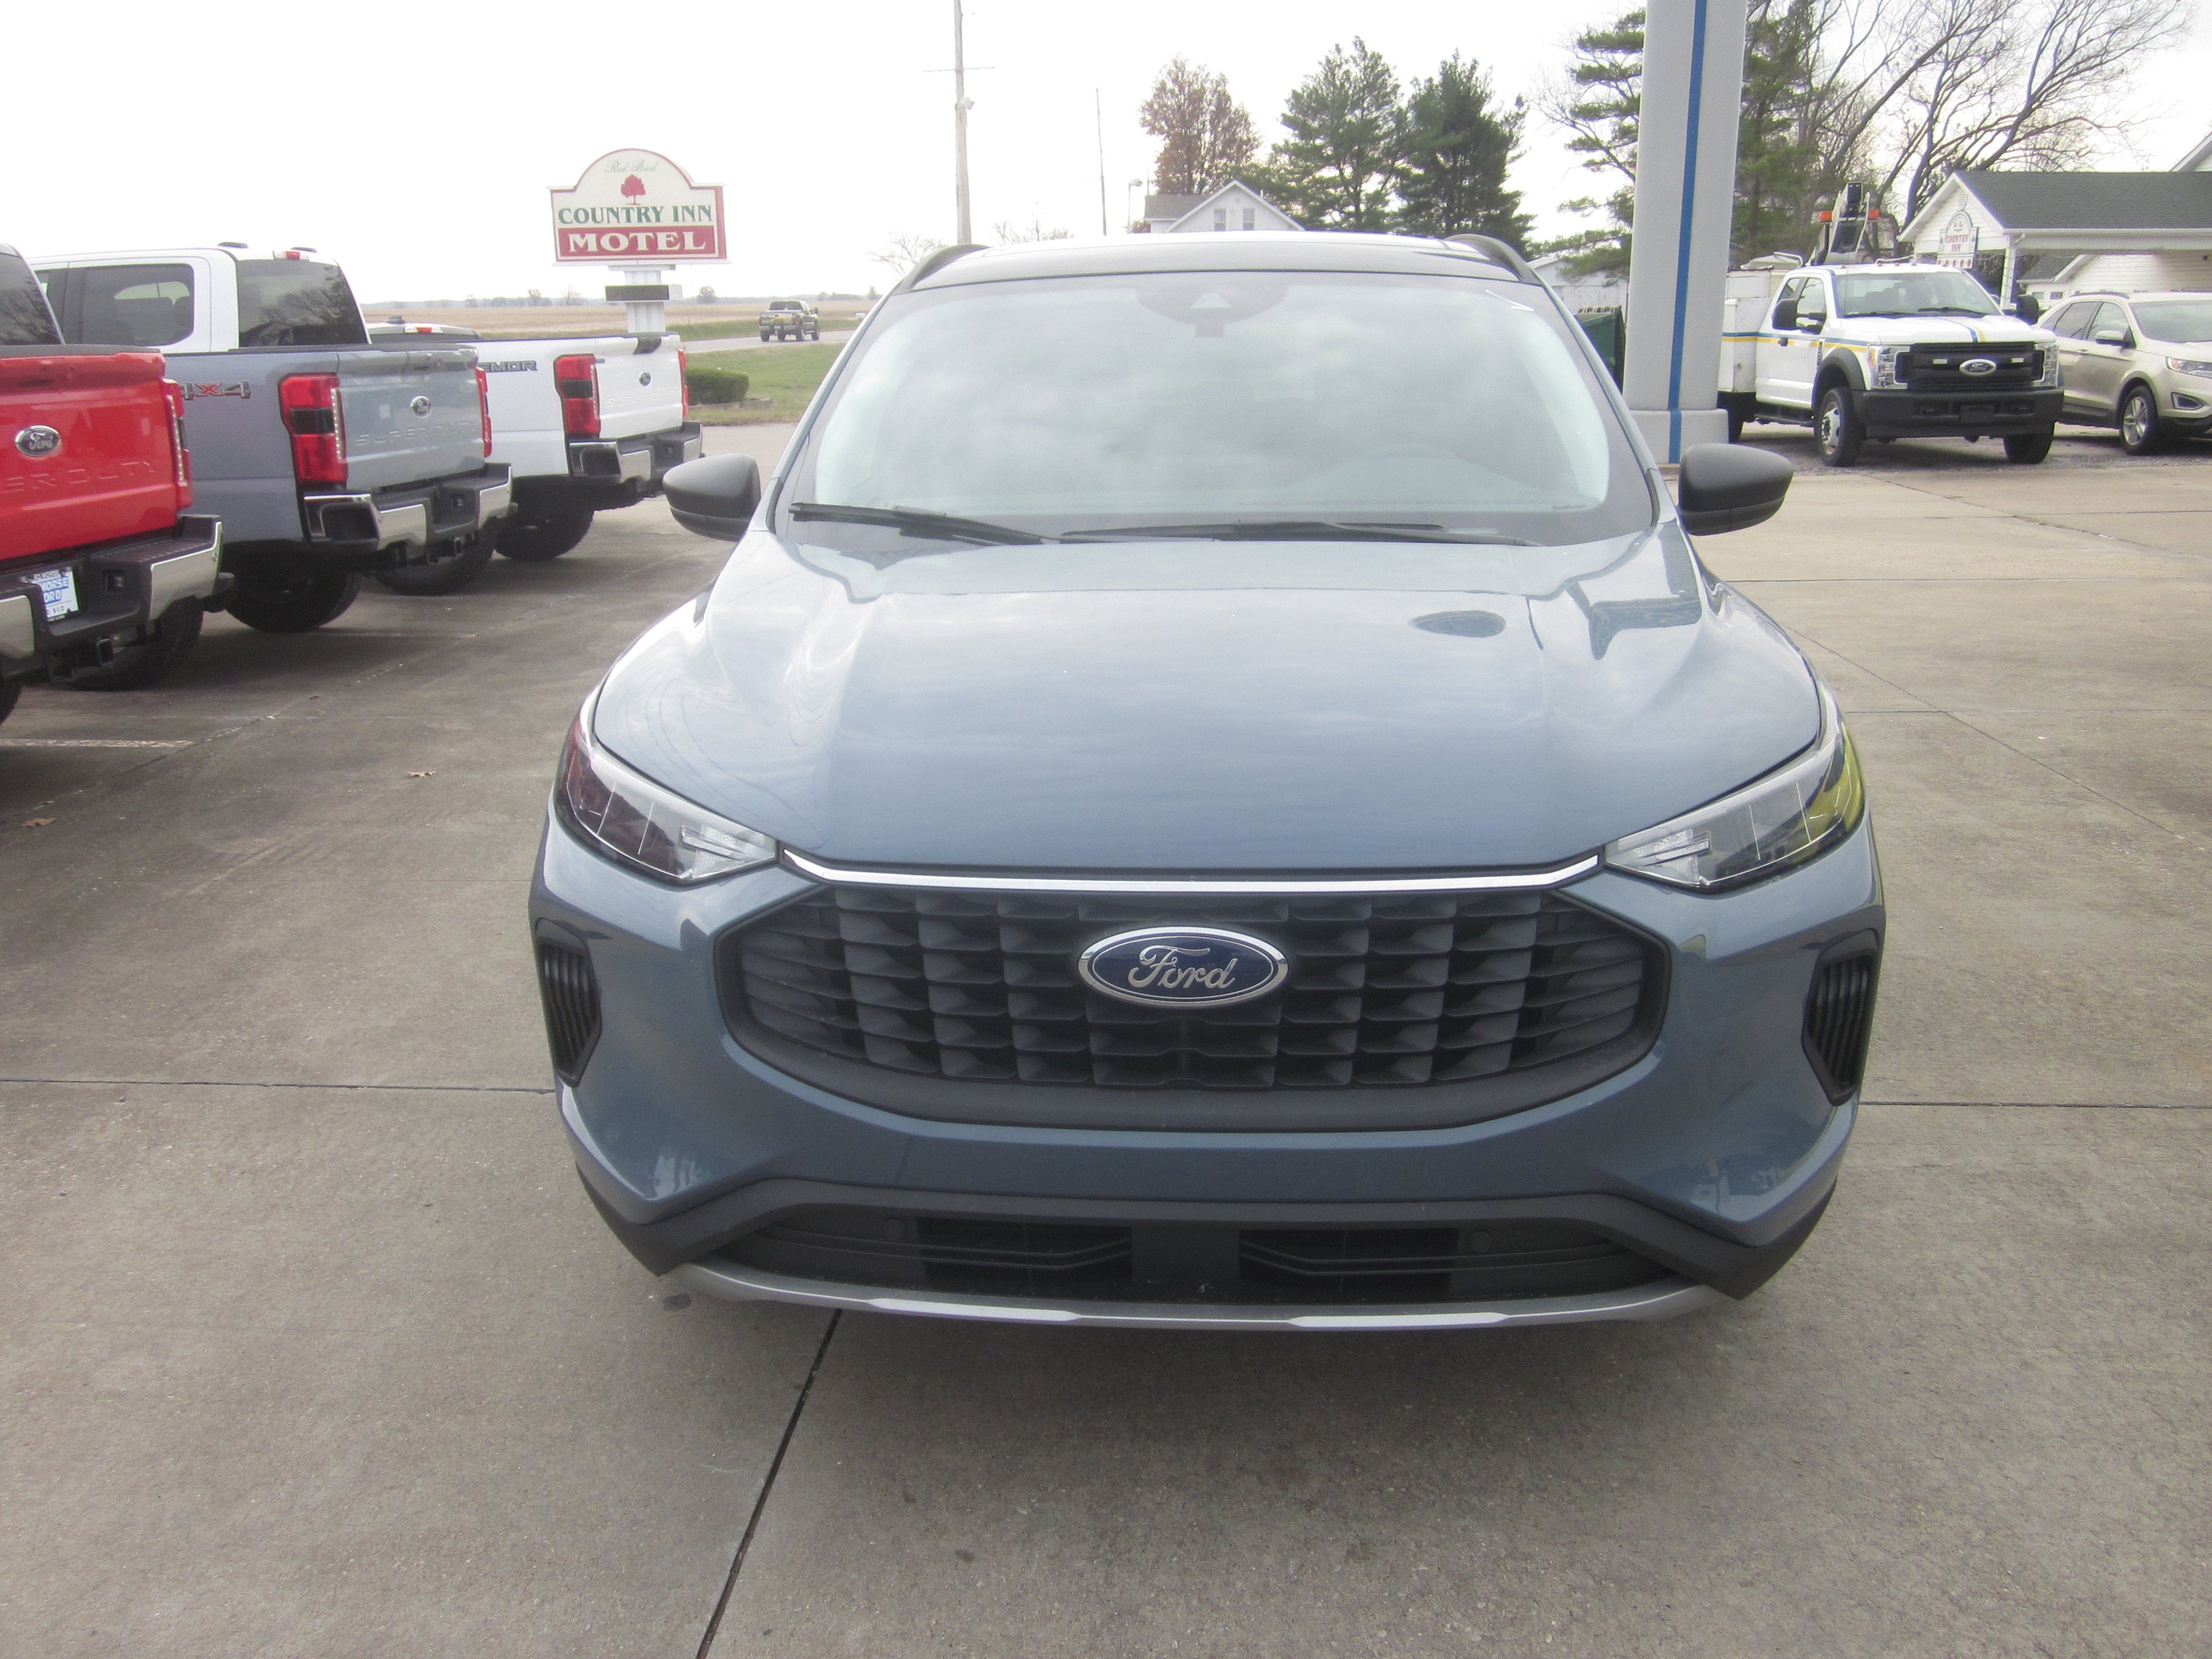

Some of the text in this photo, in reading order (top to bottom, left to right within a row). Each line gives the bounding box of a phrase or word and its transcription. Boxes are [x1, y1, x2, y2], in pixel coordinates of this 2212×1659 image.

[605, 159, 659, 173] Red Bud
[558, 205, 713, 225] COUNTRY INN
[568, 231, 706, 252] MOTEL
[29, 432, 54, 450] Ford
[1128, 945, 1238, 989] Ford
